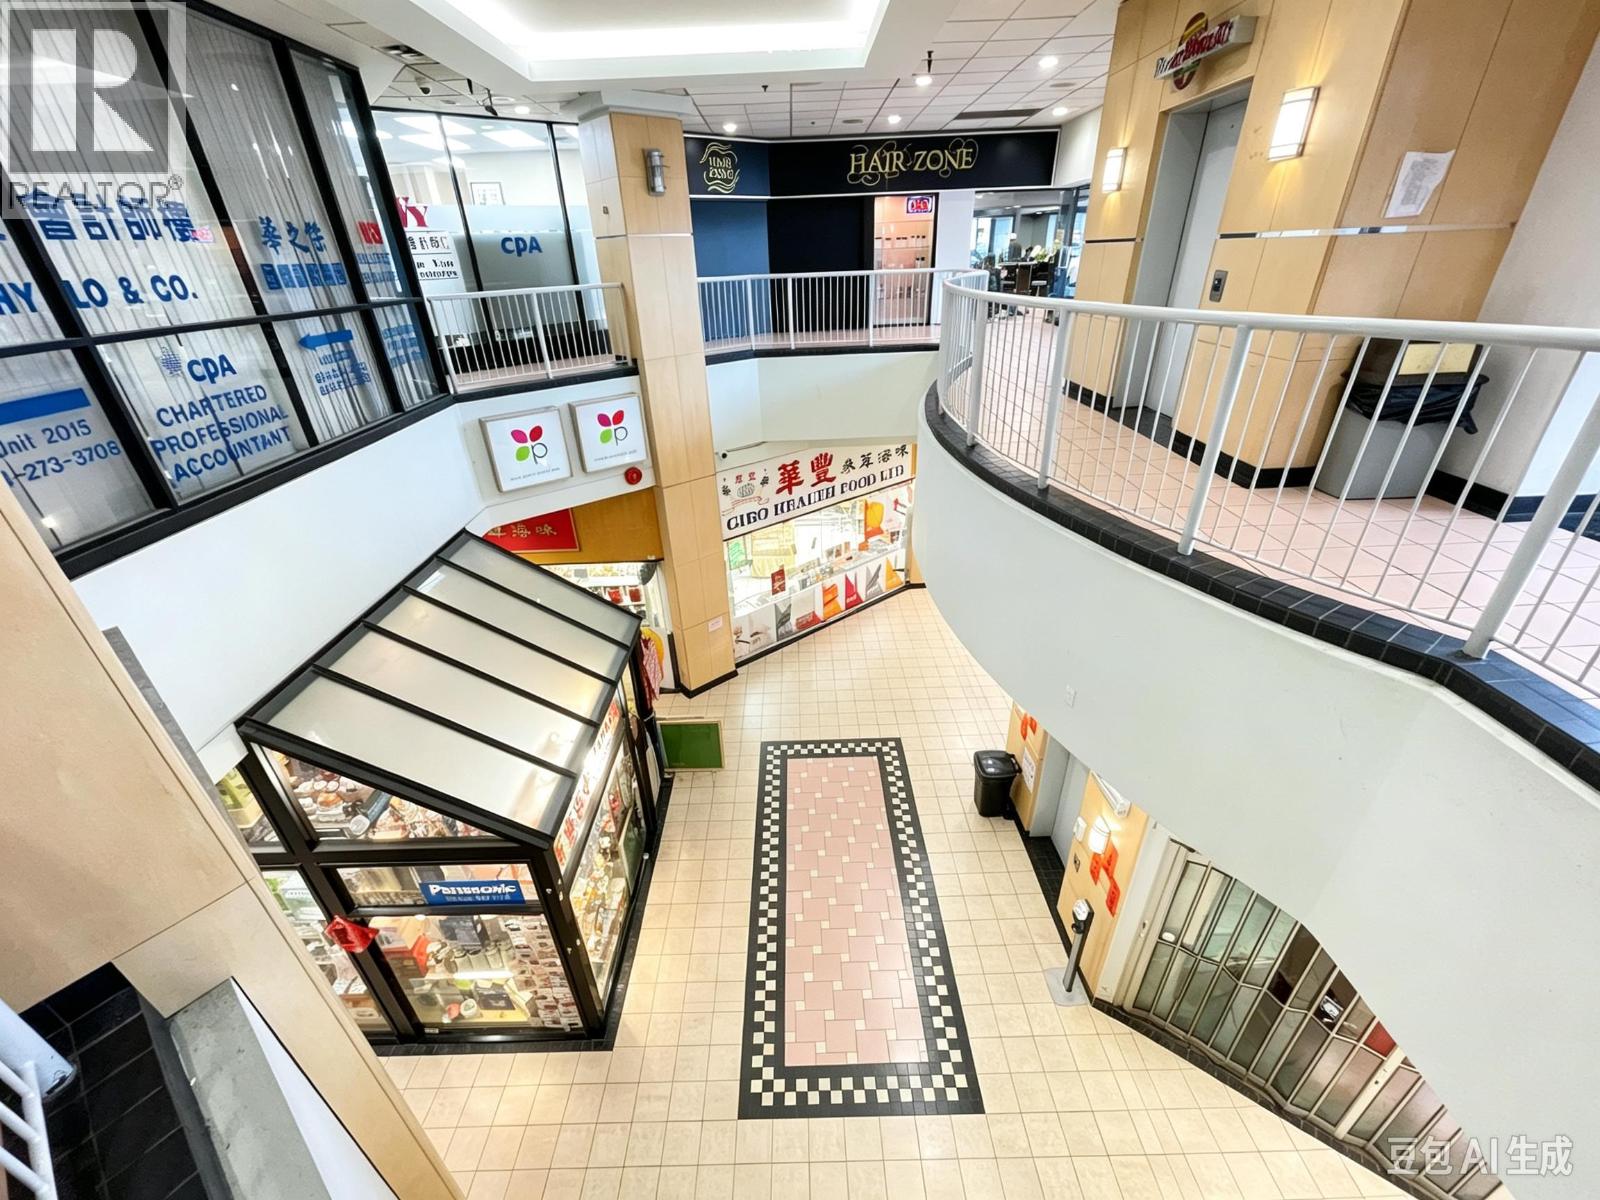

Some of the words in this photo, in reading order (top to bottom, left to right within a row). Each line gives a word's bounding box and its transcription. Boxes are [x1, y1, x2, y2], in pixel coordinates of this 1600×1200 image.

[847, 146, 908, 182] HAIR
[913, 143, 976, 175] ZONE
[60, 277, 108, 309] LO
[118, 276, 144, 304] &
[151, 274, 199, 302] CO.
[156, 384, 268, 427] CHARTERED
[41, 418, 92, 444] 2015
[150, 403, 290, 458] PROFESSIONAL
[173, 426, 291, 484] ACCOUNTANT
[775, 452, 837, 495] 華豐
